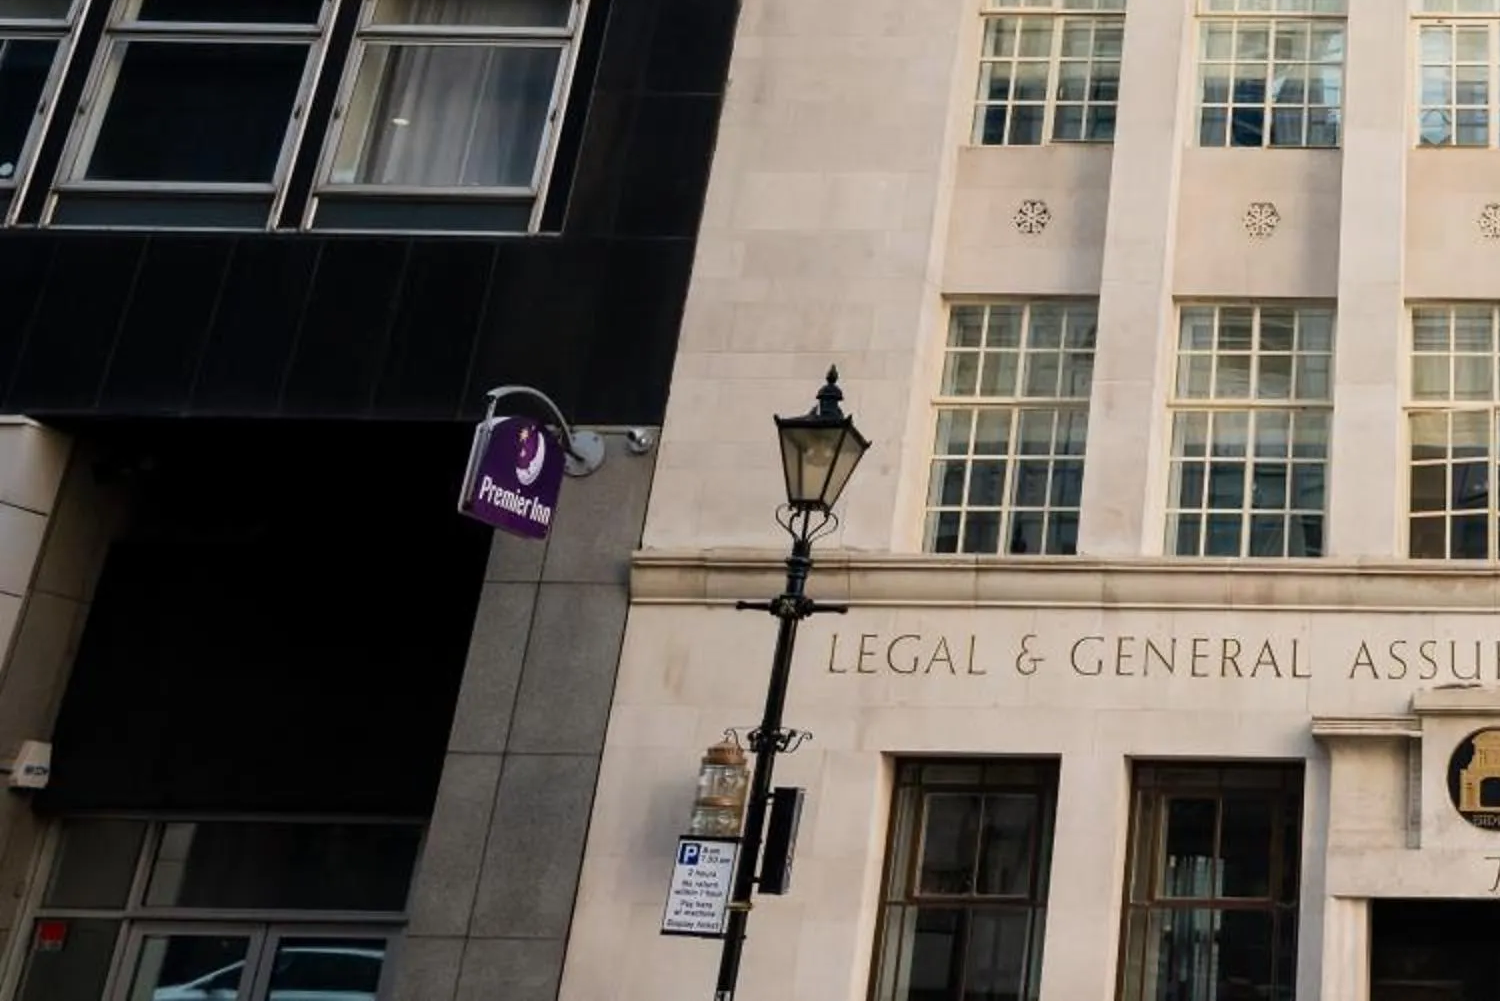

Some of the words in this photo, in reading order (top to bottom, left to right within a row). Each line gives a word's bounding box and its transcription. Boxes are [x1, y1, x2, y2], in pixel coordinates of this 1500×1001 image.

[479, 475, 532, 516] Premier
[530, 496, 551, 525] Inn
[828, 634, 986, 675] LEGAL
[1016, 634, 1045, 674] &
[1070, 636, 1312, 679] GENERAL
[684, 845, 698, 863] P
